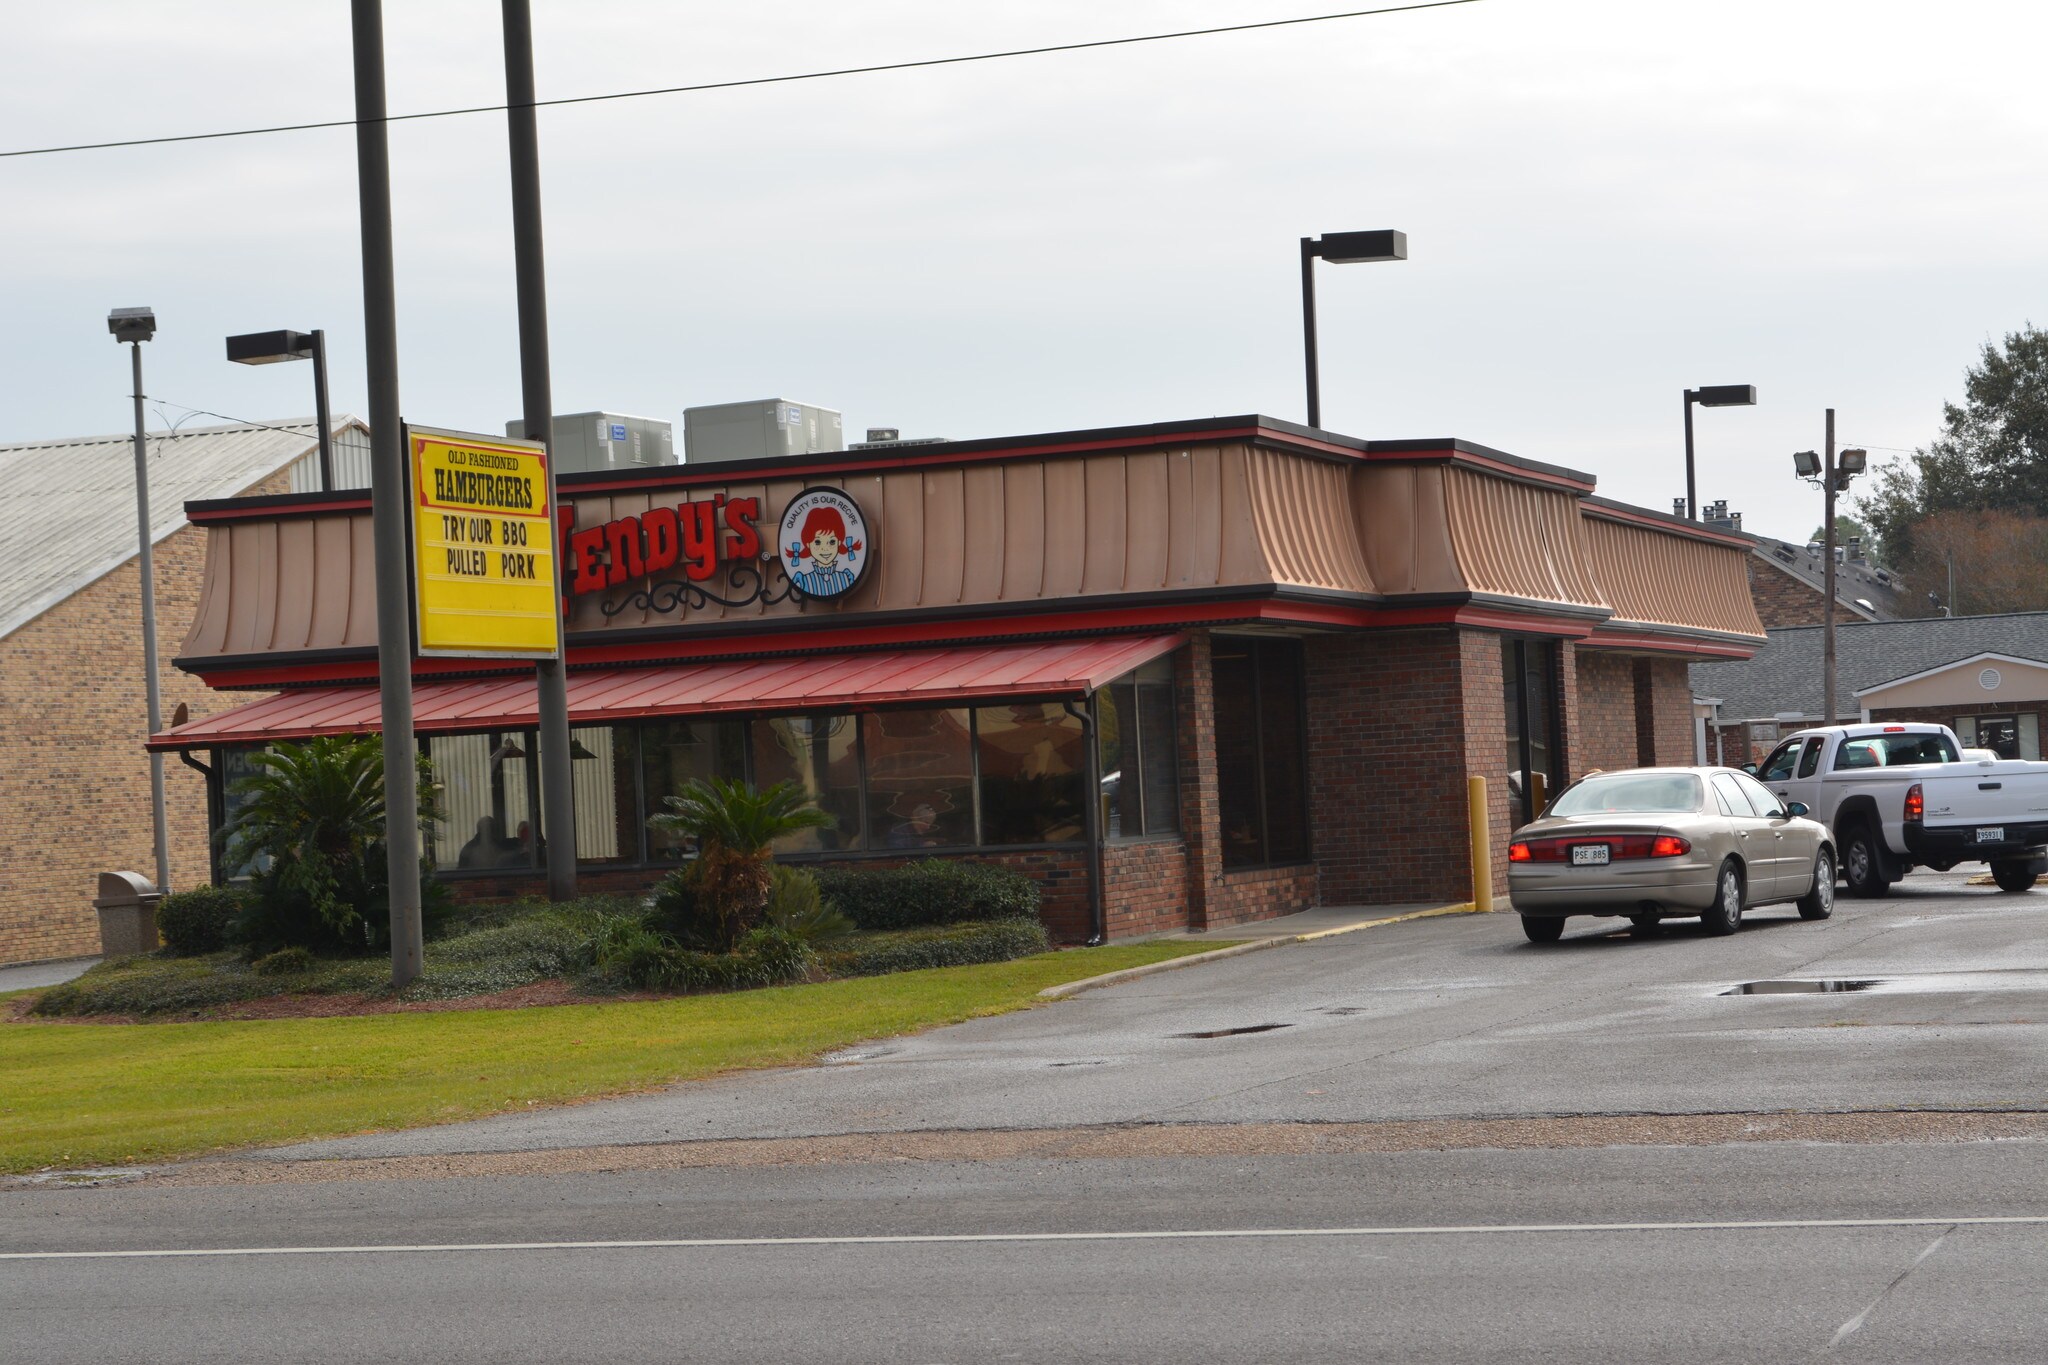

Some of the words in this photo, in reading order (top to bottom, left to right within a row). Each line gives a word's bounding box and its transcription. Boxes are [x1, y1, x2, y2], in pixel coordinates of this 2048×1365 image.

[448, 450, 466, 465] OLD
[468, 453, 519, 471] FASHIONED
[434, 468, 533, 509] HAMBURGERS
[786, 501, 810, 529] QUALITY
[811, 497, 819, 505] IS
[820, 496, 837, 505] OUR
[837, 501, 858, 526] RECIPE
[443, 515, 466, 542] TRY
[469, 518, 493, 545] OUR
[503, 522, 527, 547] BBQ
[447, 549, 487, 576] PULLED
[502, 553, 536, 579] PORK
[1574, 850, 1588, 860] PSE
[1592, 849, 1607, 859] 885
